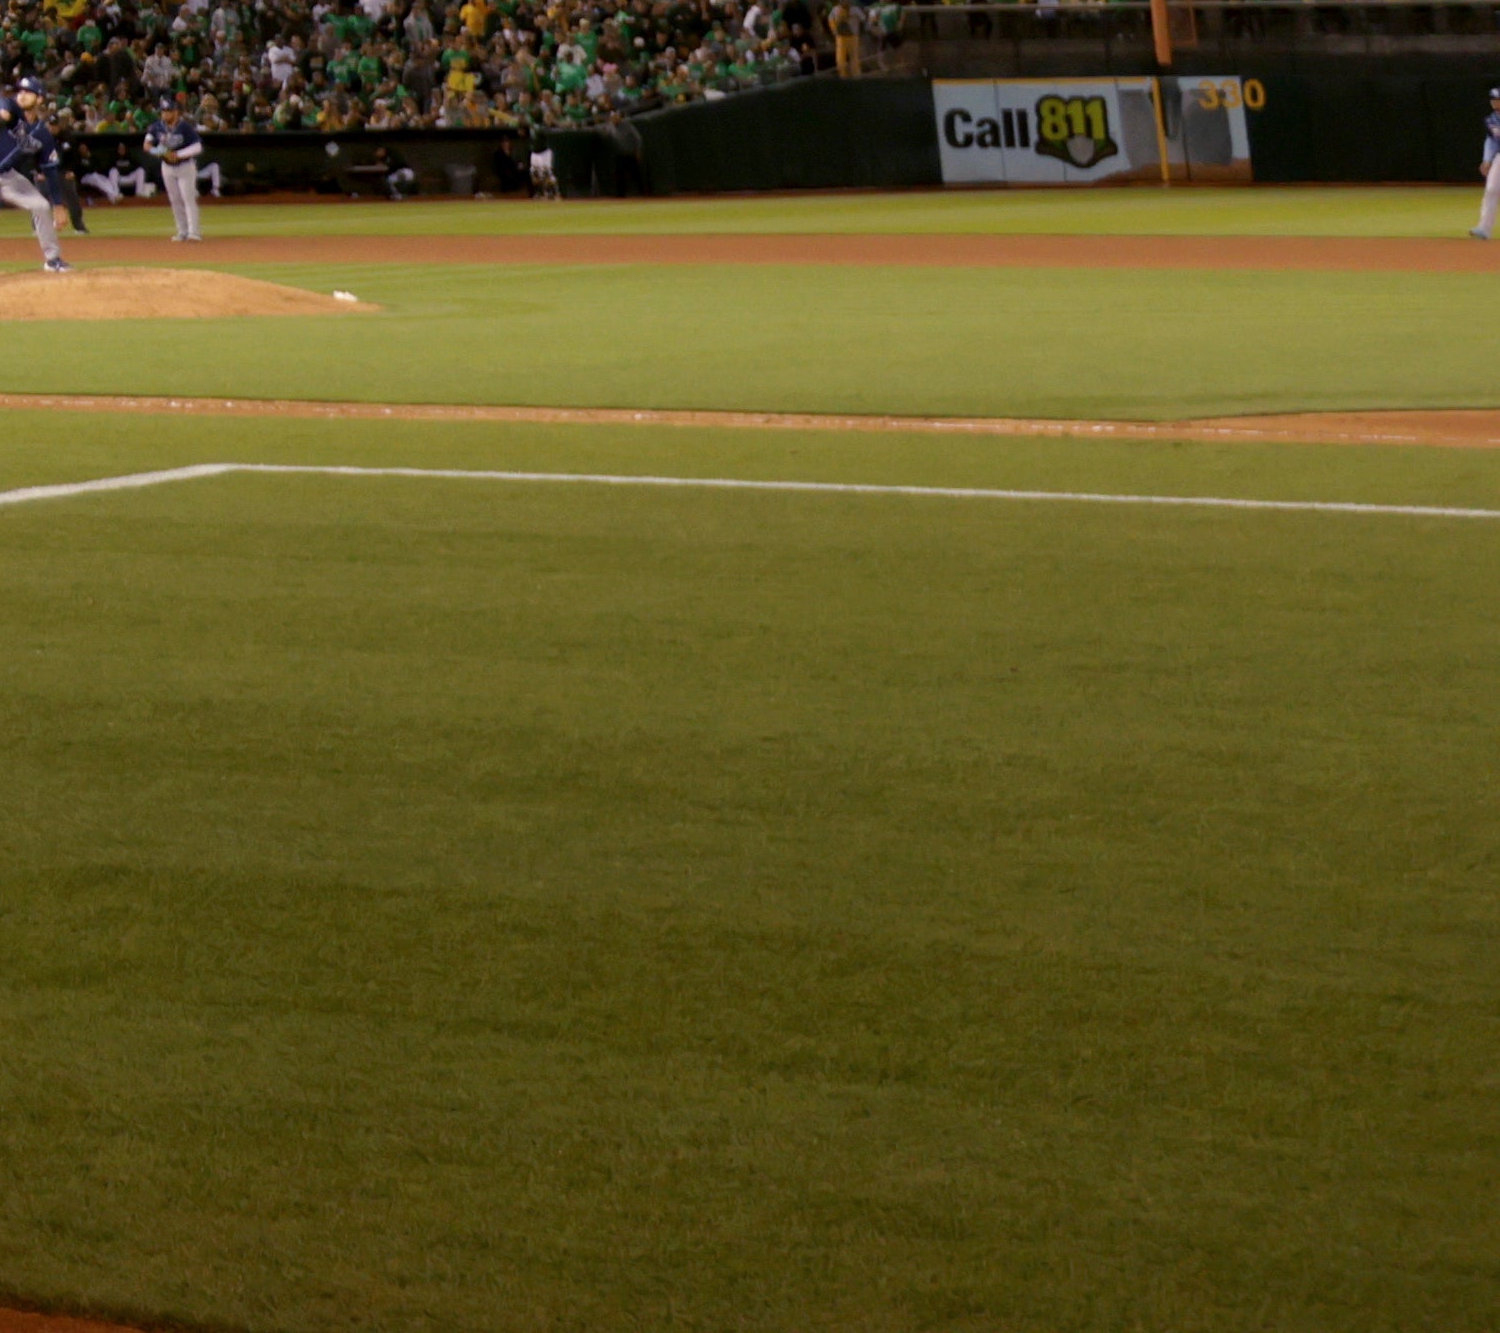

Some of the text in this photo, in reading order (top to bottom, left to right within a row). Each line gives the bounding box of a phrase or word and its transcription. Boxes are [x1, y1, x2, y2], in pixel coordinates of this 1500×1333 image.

[1198, 79, 1268, 107] 330
[943, 95, 1108, 149] Call 811
